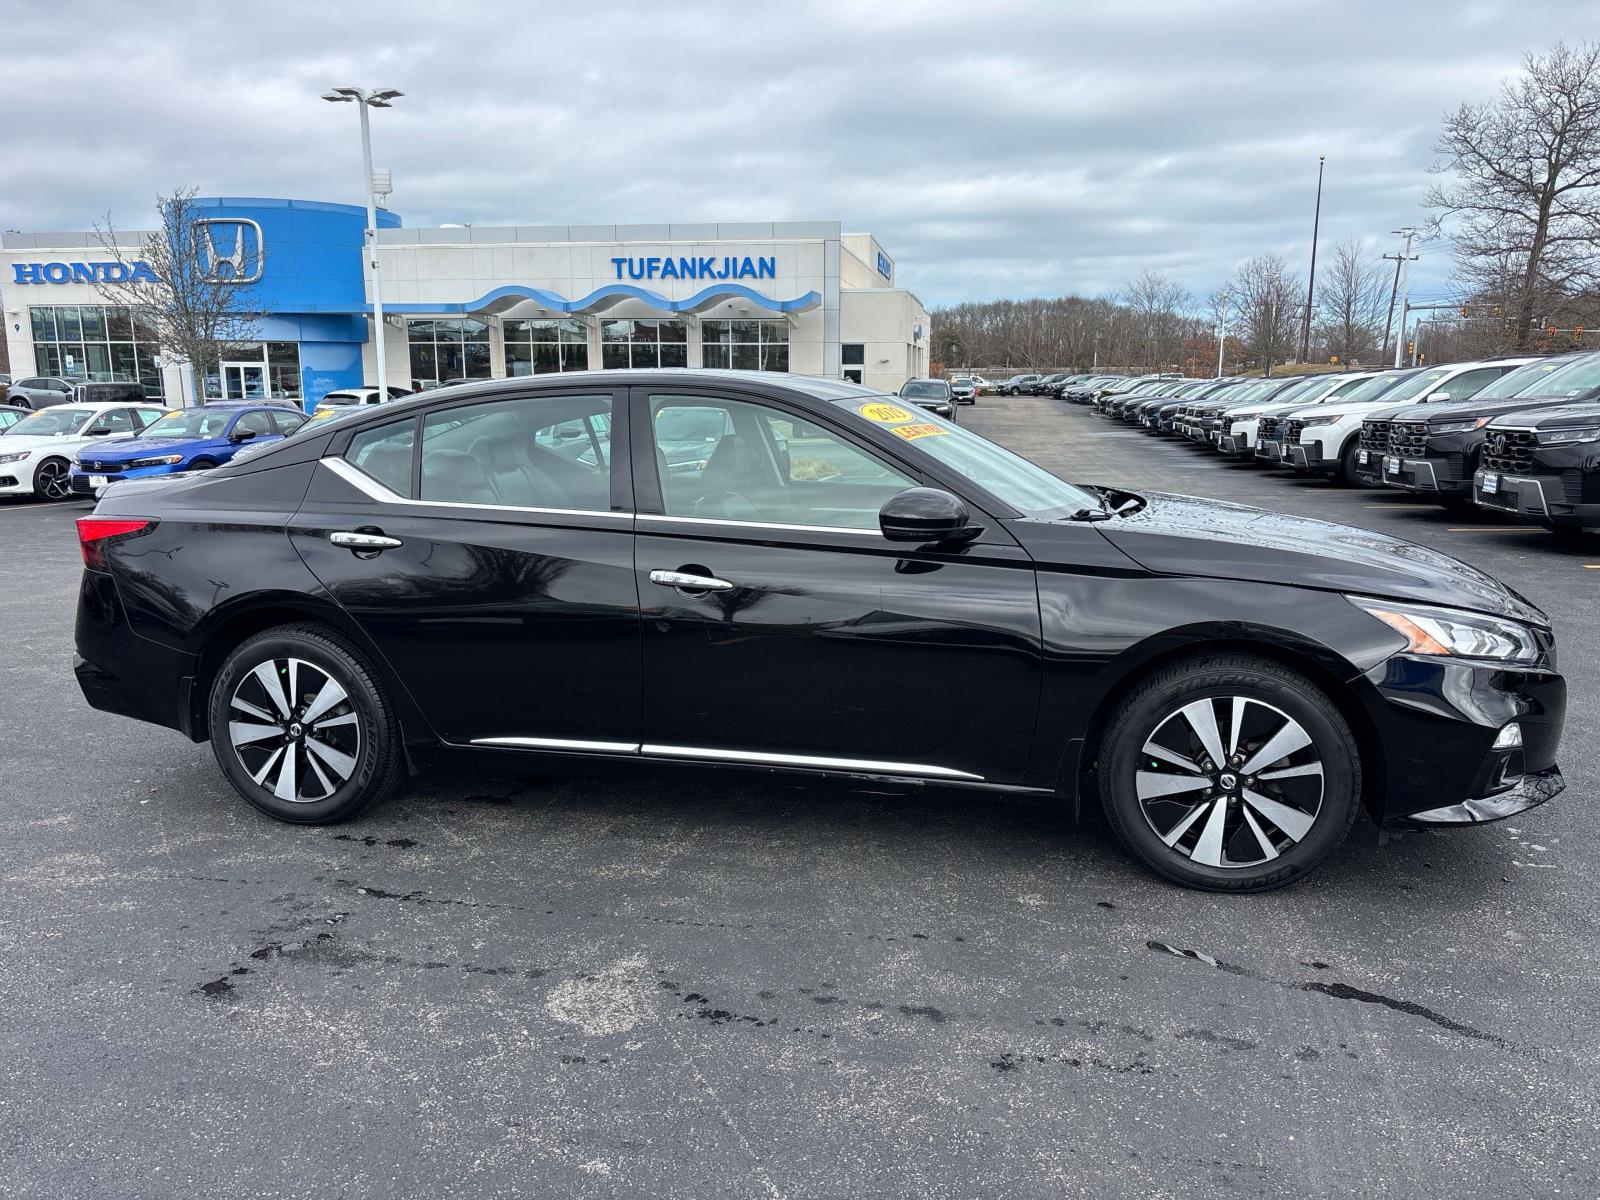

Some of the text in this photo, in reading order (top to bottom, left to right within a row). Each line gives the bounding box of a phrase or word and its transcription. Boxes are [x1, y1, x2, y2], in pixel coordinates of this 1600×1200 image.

[12, 262, 163, 284] HONDA
[611, 257, 776, 279] TUFANKJIAN
[14, 323, 20, 332] 9
[869, 407, 906, 420] 2019
